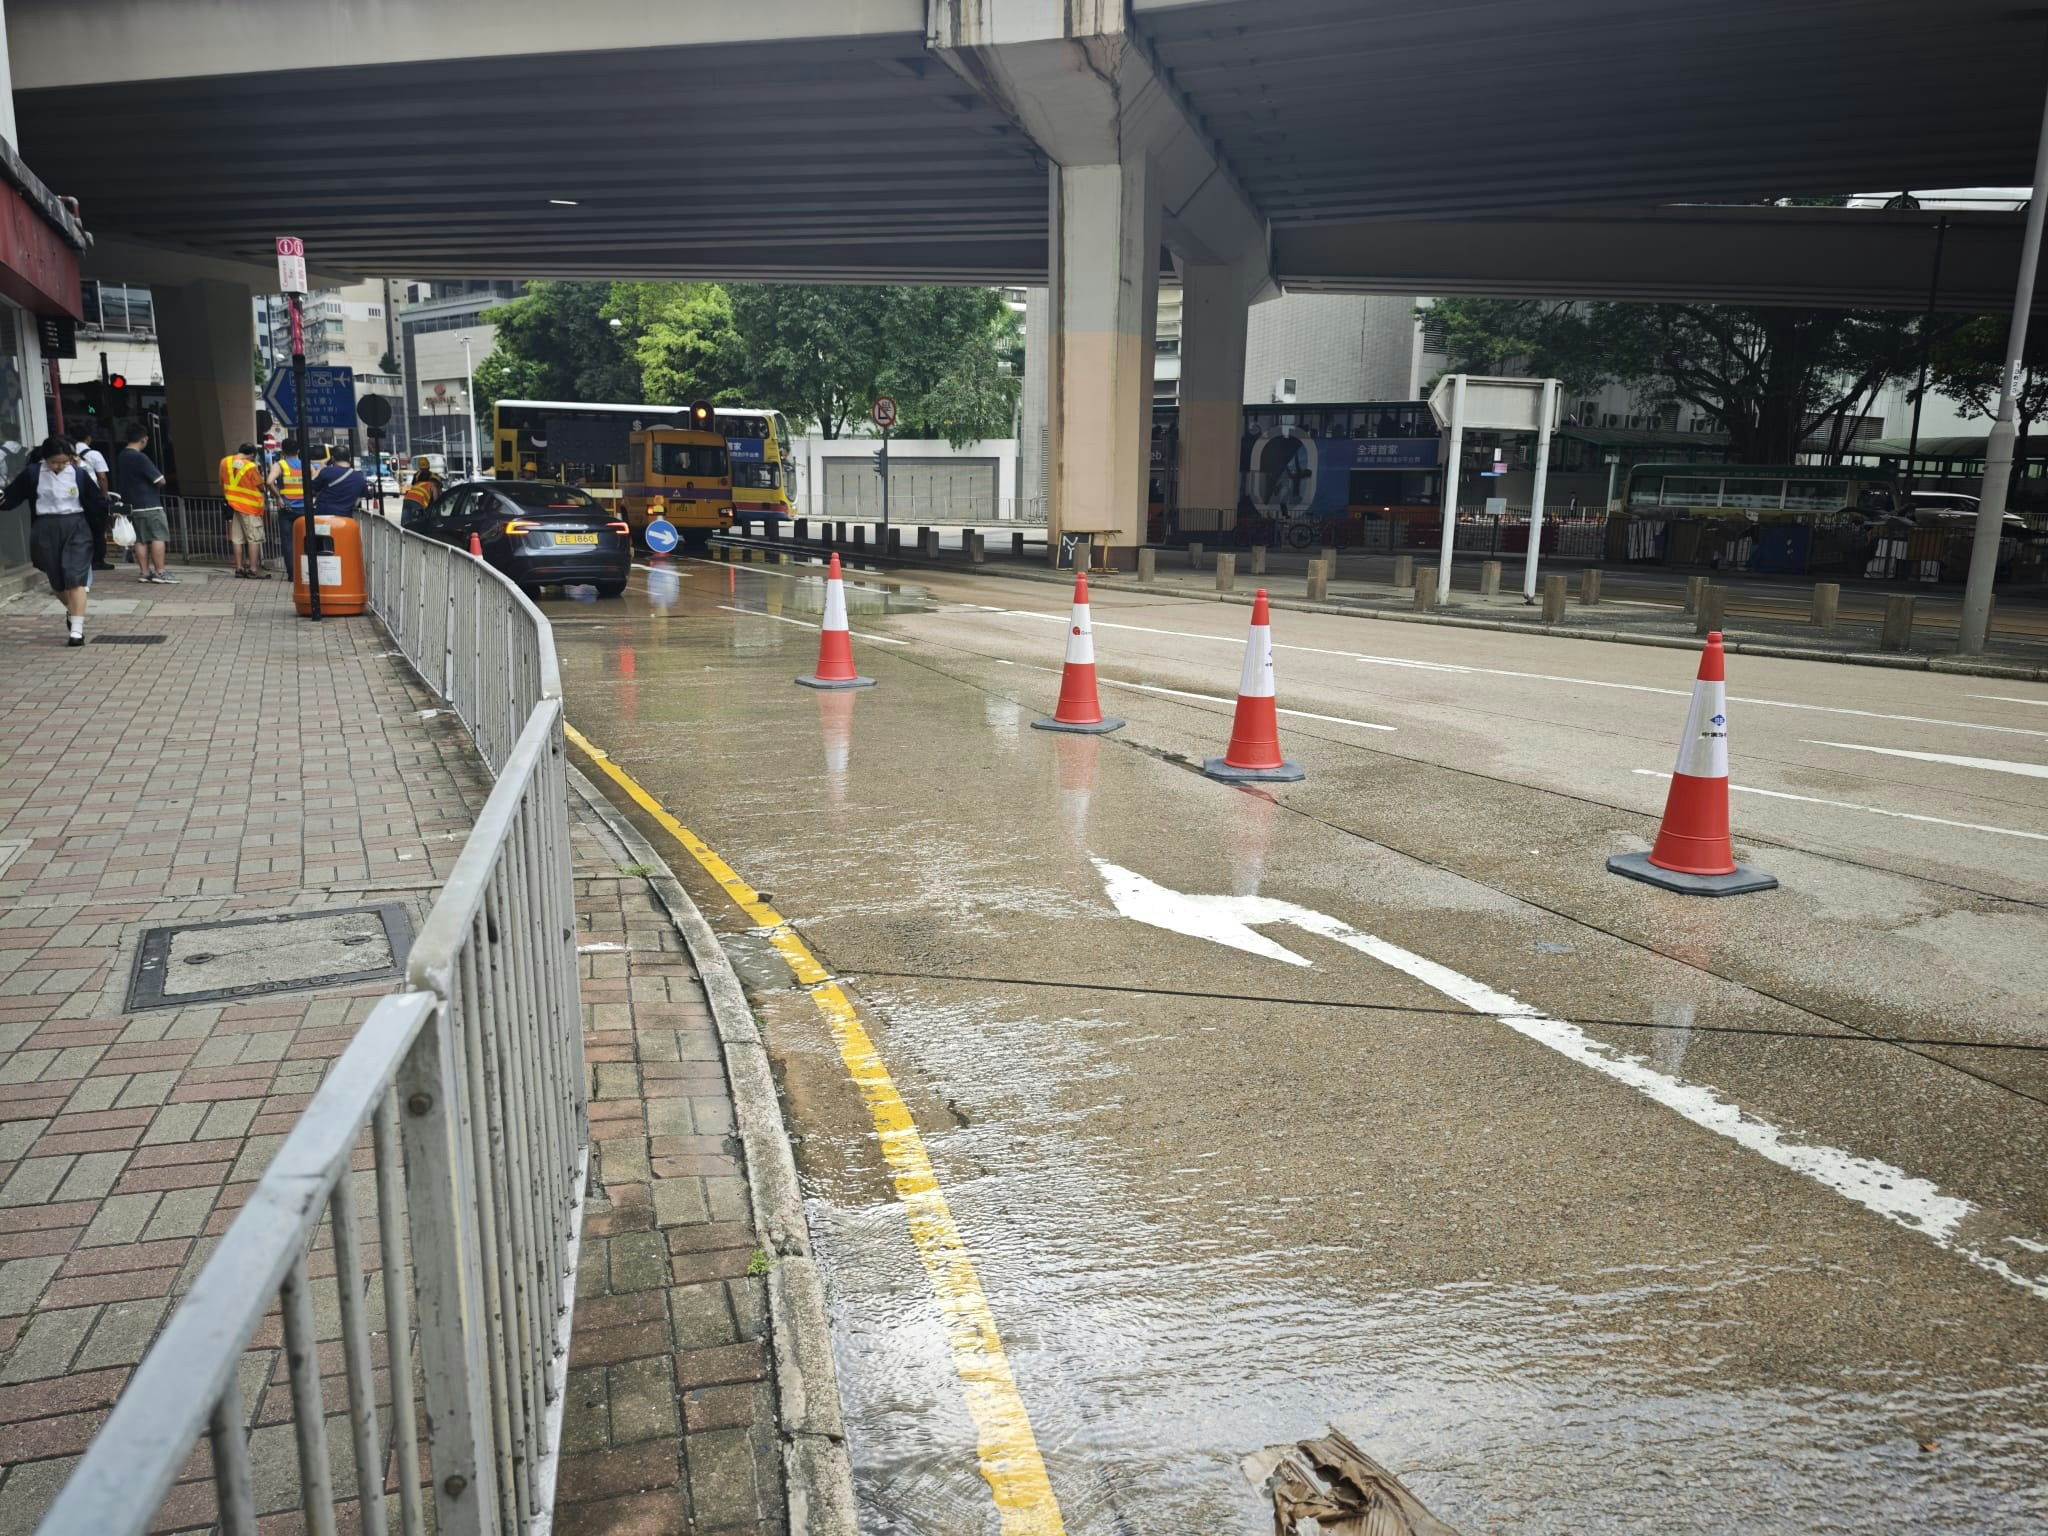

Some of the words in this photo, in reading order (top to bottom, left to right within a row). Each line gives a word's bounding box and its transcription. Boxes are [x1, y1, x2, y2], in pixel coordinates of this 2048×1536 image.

[1357, 444, 1399, 456] 全港首家
[559, 535, 571, 543] ZE
[574, 535, 594, 543] 1860
